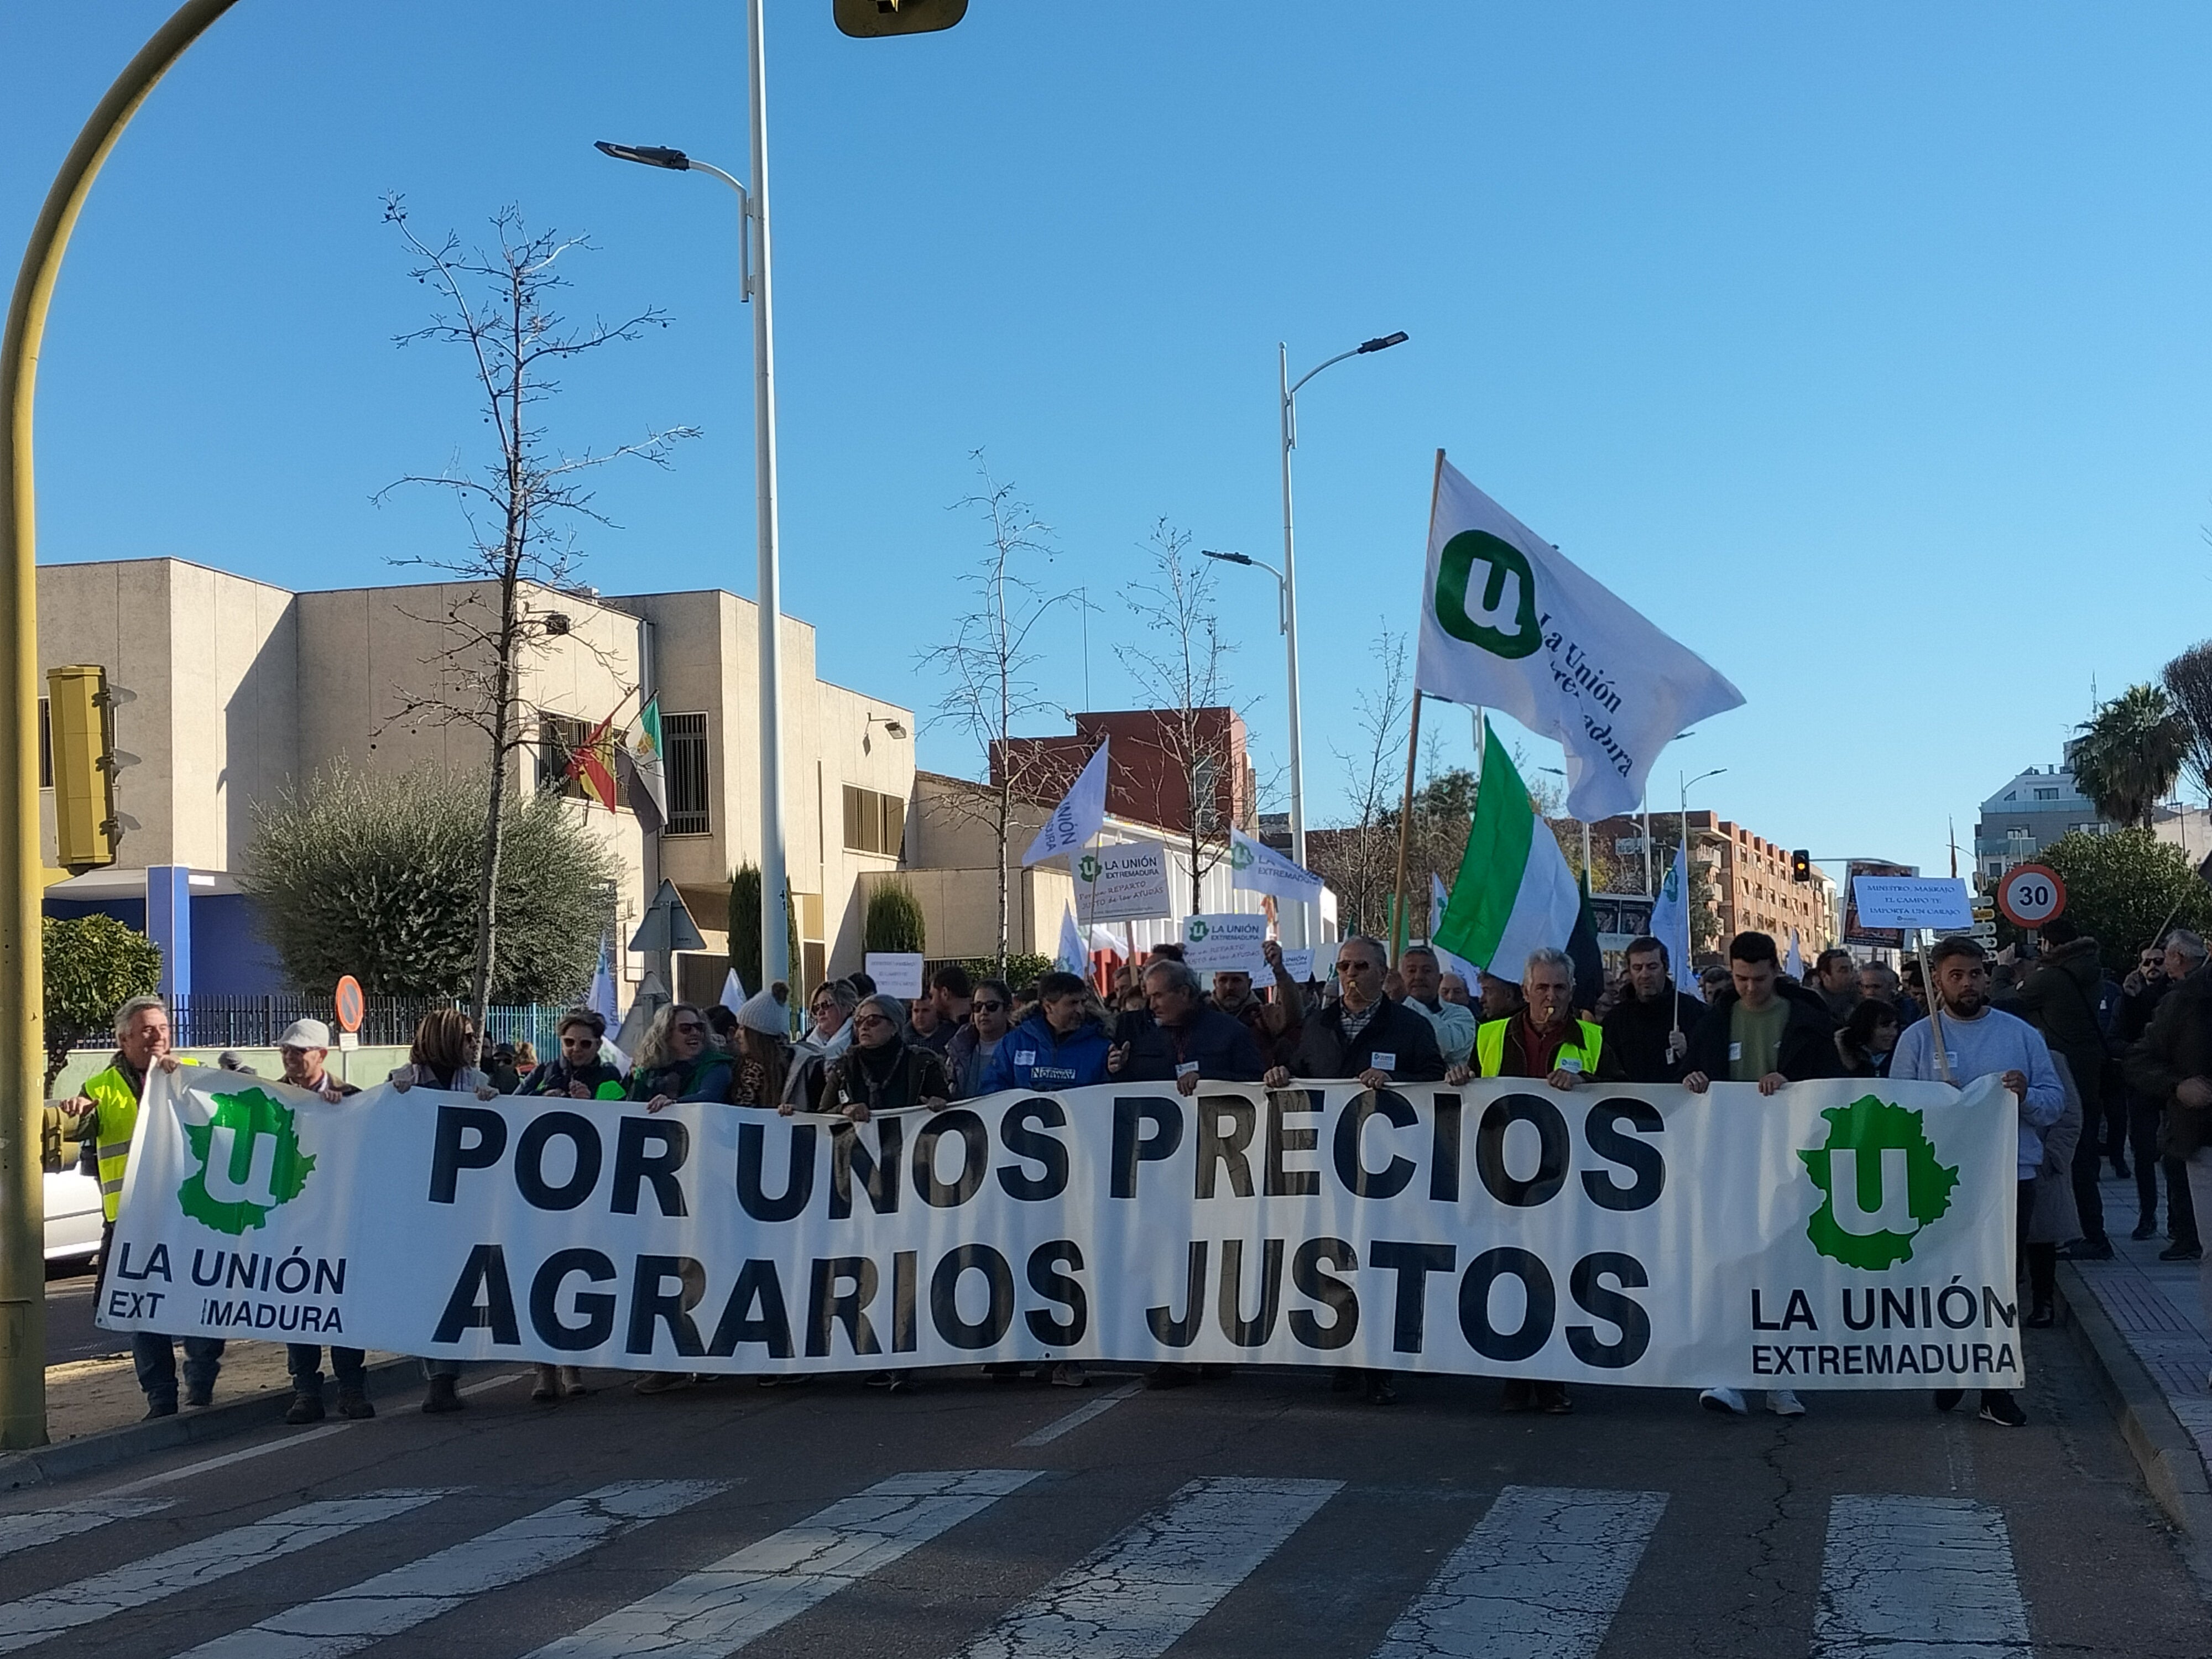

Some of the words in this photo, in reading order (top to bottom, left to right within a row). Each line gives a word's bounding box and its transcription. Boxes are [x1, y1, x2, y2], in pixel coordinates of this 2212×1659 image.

[1566, 643, 1623, 714] Unión
[1057, 801, 1078, 846] NIÓN
[1104, 860, 1118, 870] LA
[1122, 855, 1157, 869] UNIÓN
[1106, 869, 1159, 879] EXTREMADURA
[1108, 880, 1146, 894] REPARTO
[1133, 887, 1164, 899] AYUDAS
[2019, 886, 2048, 906] 30
[1227, 923, 1259, 933] UNIÓN
[429, 1105, 689, 1218] POR
[735, 1097, 1070, 1222] UNOS
[1110, 1089, 1666, 1211] PRECIOS
[117, 1242, 173, 1282] LA
[191, 1246, 347, 1295] UNIÓN
[431, 1239, 1087, 1359] AGRARIOS
[1146, 1237, 1651, 1369] JUSTOS
[1751, 1288, 1818, 1331] LA
[1842, 1275, 2016, 1330] UNIÓN
[1752, 1343, 2017, 1375] EXTREMADURA
